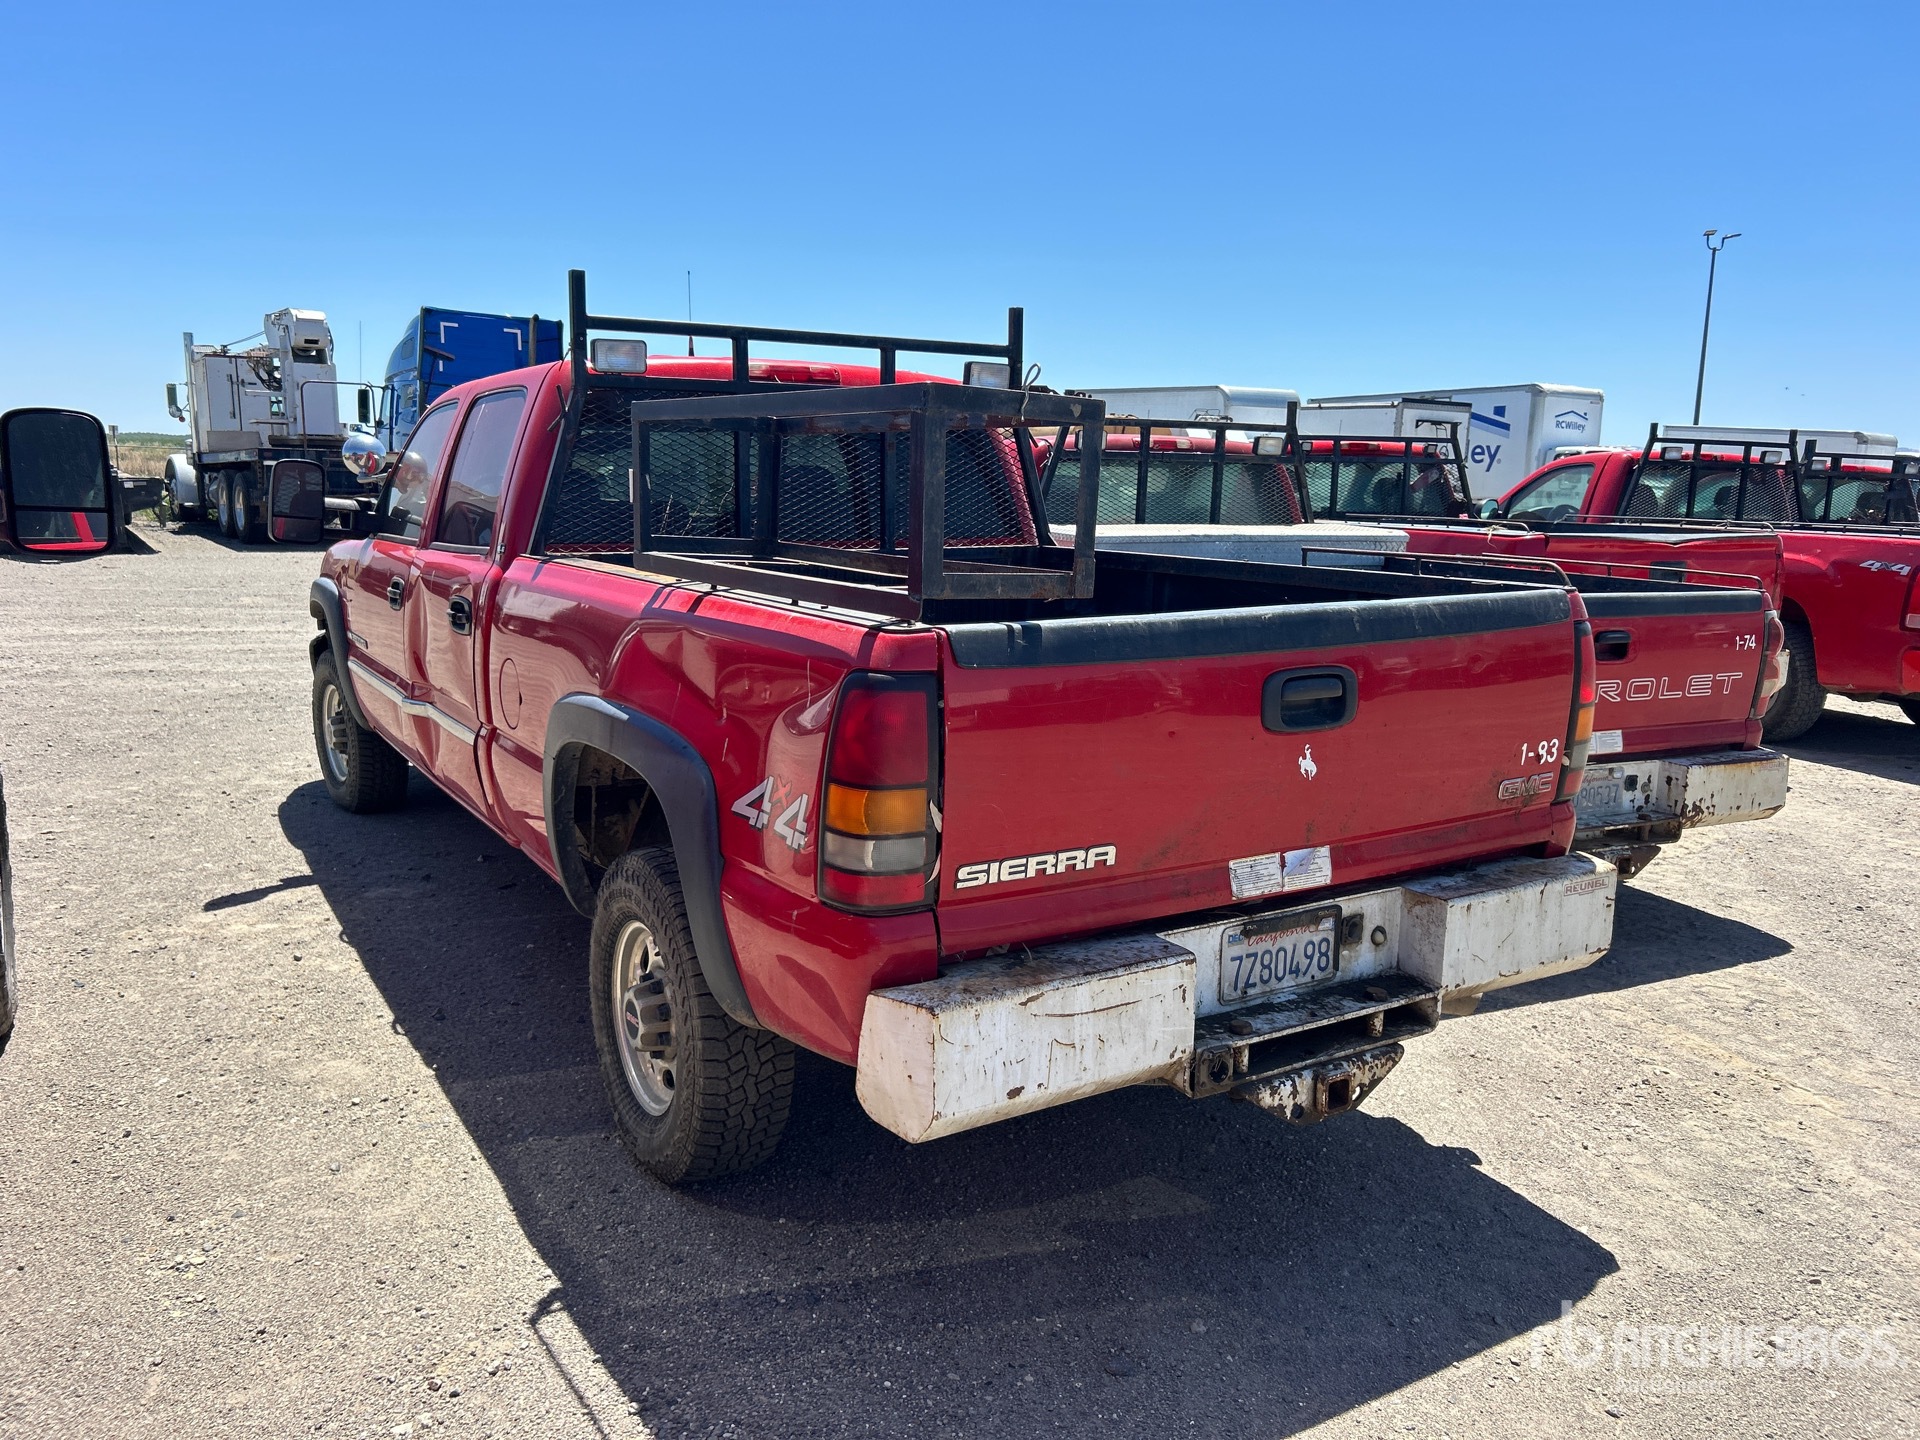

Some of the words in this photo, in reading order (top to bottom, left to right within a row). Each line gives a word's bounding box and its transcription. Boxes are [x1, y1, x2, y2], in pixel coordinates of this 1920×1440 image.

[1735, 634, 1757, 650] 1-74
[1498, 770, 1554, 800] GMC
[955, 843, 1117, 889] SIERRA
[1230, 937, 1331, 992] 7Z80498
